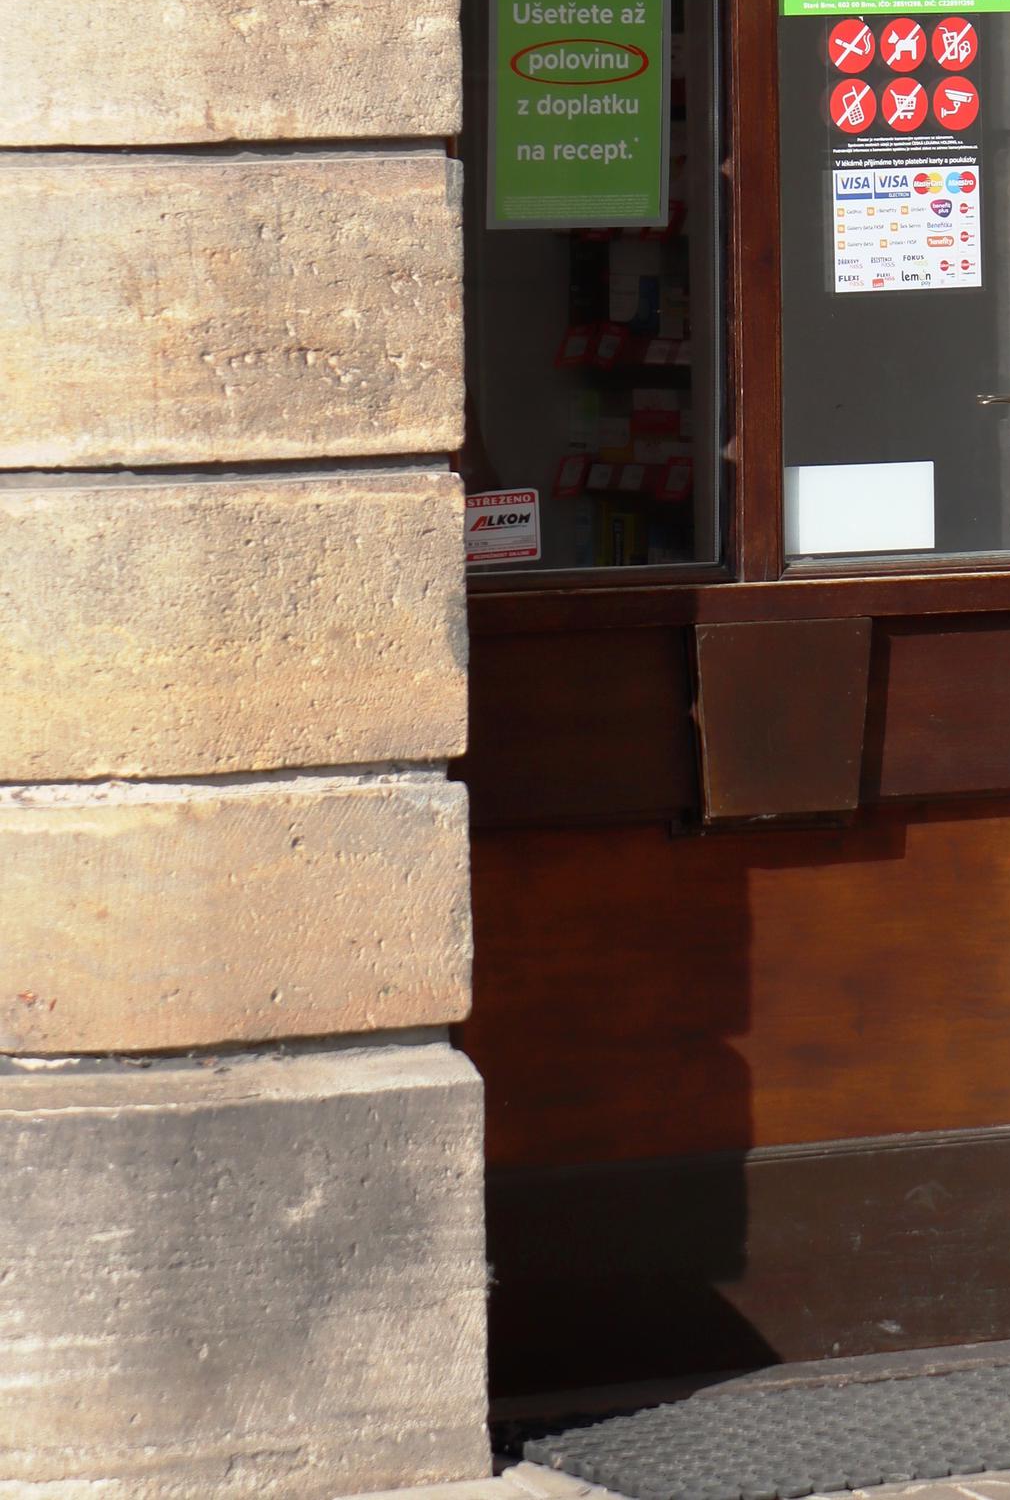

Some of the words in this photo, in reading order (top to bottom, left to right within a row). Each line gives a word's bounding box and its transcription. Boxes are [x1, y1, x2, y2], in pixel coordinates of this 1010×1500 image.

[513, 2, 613, 25] Ušetřete
[620, 2, 646, 25] až
[528, 48, 629, 74] polovinu
[517, 100, 529, 115] z
[536, 94, 639, 119] doplatku
[517, 145, 545, 160] na
[841, 176, 870, 190] VISA
[879, 175, 909, 188] VISA
[470, 512, 531, 532] ALKOM
